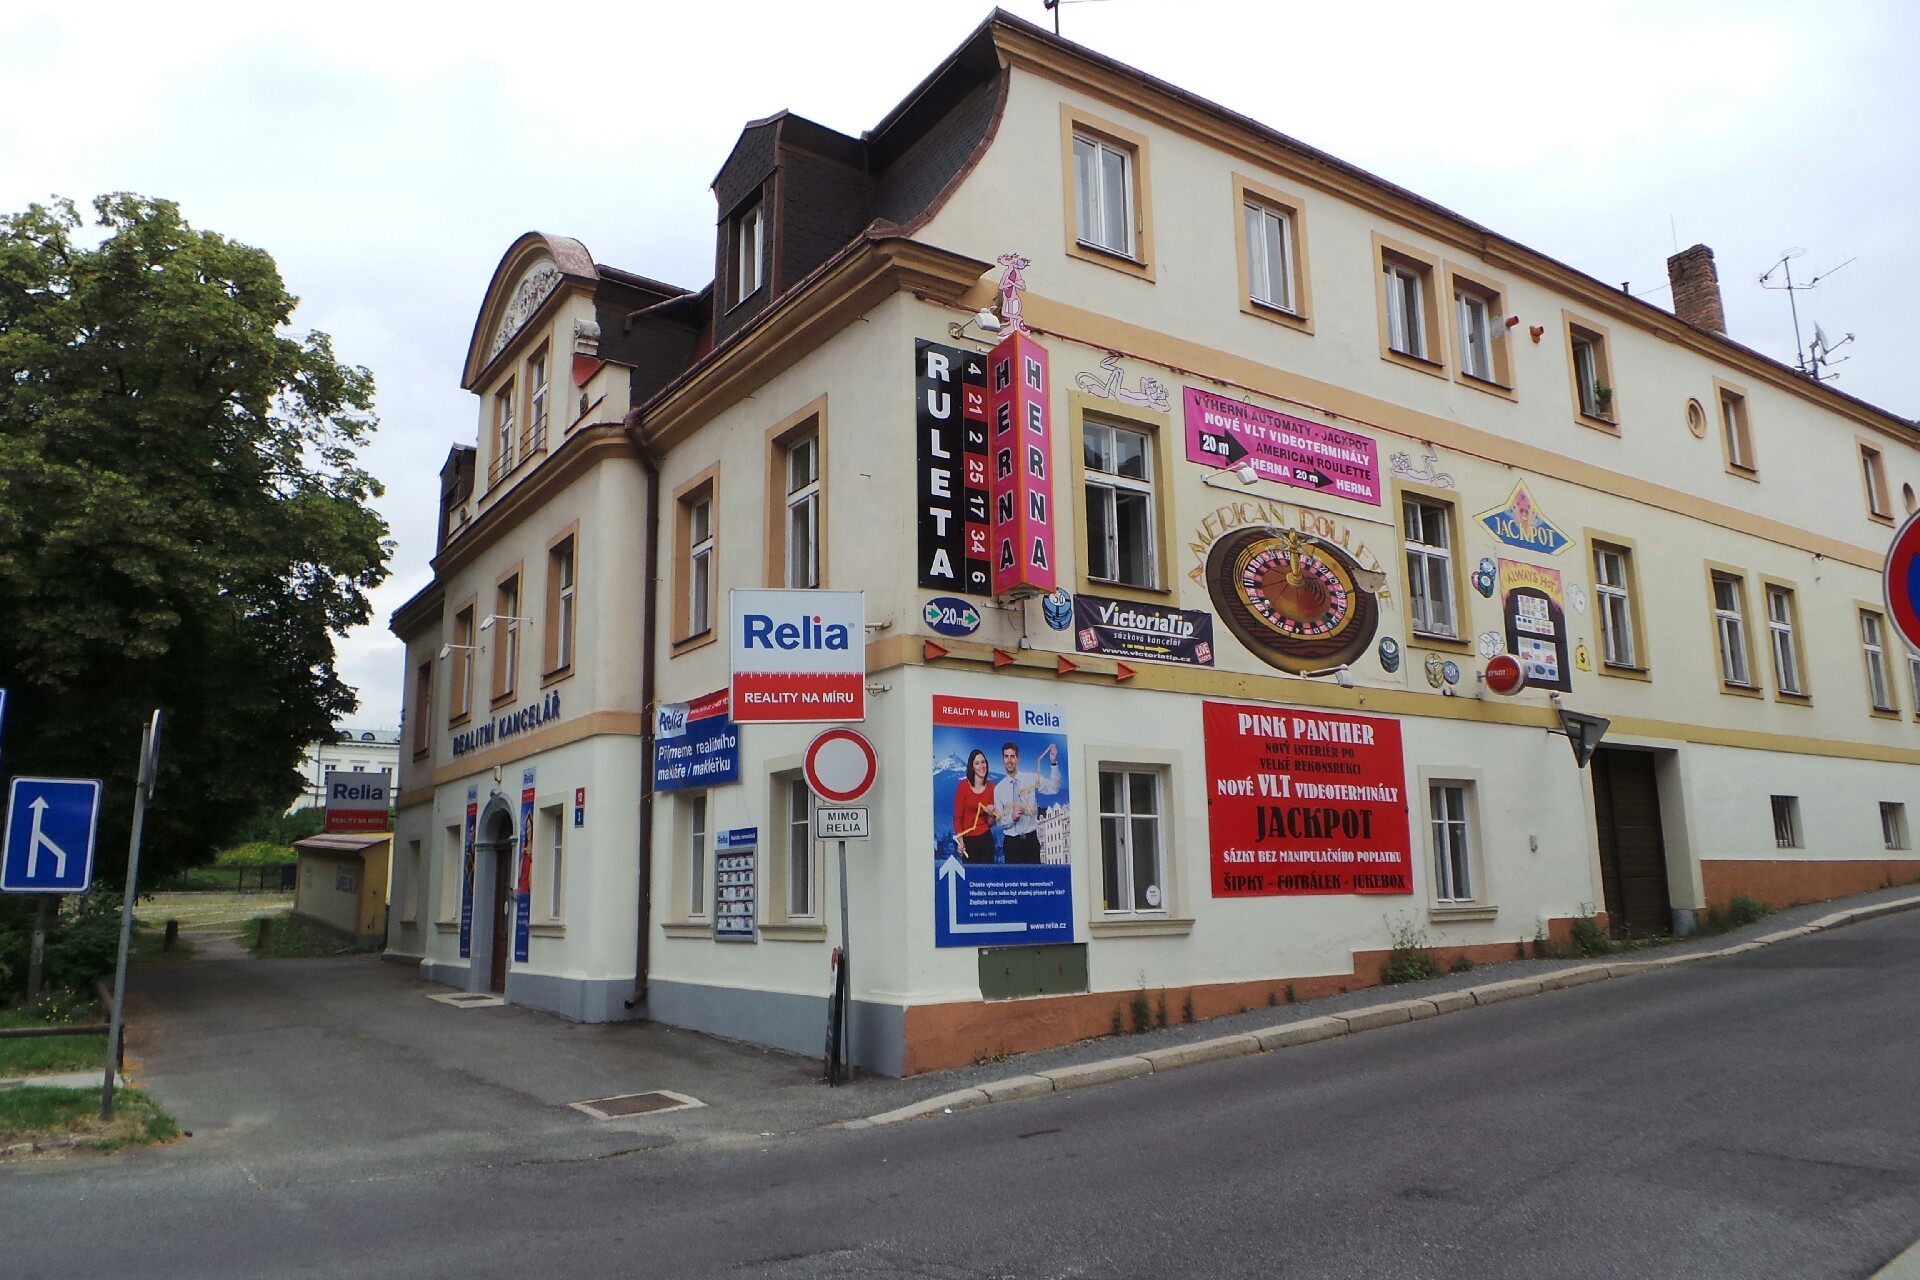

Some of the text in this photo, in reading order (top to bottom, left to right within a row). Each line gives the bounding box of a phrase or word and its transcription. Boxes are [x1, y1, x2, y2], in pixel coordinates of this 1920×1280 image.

[967, 362, 982, 375] 4
[968, 392, 983, 415] 21
[1194, 394, 1248, 418] VÝHERNÍ
[1251, 411, 1312, 436] AUTOMATY
[1322, 431, 1369, 453] JACKPOT
[969, 431, 983, 444] 2
[1202, 434, 1230, 456] 20 m
[1204, 411, 1370, 466] NOVÉ VLT VIDEOTERMINÁLY
[927, 351, 954, 578] RULETA
[969, 459, 984, 484] 25
[995, 356, 1015, 572] HERNA
[1025, 355, 1048, 571] HERNA
[1256, 442, 1371, 480] AMERICAN ROULETTE
[1250, 458, 1373, 497] HERNA 20 m HERNA
[970, 496, 985, 518] 17
[971, 529, 986, 554] 34
[1495, 516, 1555, 548] JACKPOT
[1507, 569, 1538, 583] ALWAYS
[1099, 601, 1194, 639] VictoriaTip
[743, 614, 849, 650] Relia
[1113, 632, 1181, 647] sázková kancelář
[1101, 647, 1192, 663] www.victoriatip.cz
[744, 690, 854, 704] REALITY NA MÍRU
[453, 689, 560, 756] REALITNÍ KANCELÁŘ
[660, 709, 684, 732] Relia
[942, 706, 1011, 719] REALITY NA MÍRU
[1024, 709, 1060, 728] Relia
[1237, 712, 1375, 746] PINK PANTHER
[1265, 740, 1355, 759] NOVÝ INTERIÉR PO
[657, 763, 686, 781] makléře
[692, 756, 731, 776] makléřku
[1260, 757, 1290, 771] VELKÉ
[333, 783, 383, 800] Relia
[1217, 773, 1399, 803] NOVÉ VLT VIDEOTERMINÁLY
[826, 823, 861, 833] RELIA
[827, 812, 859, 821] MIMO
[1254, 805, 1373, 843] JACKPOT
[1223, 848, 1402, 863] SÁZKY BEZ MANIPULAČNÍHO POPLATKU
[1223, 871, 1264, 891] ŠIPKY
[1277, 870, 1341, 890] FOTBÁLEK
[1352, 874, 1405, 890] JUKEBOX
